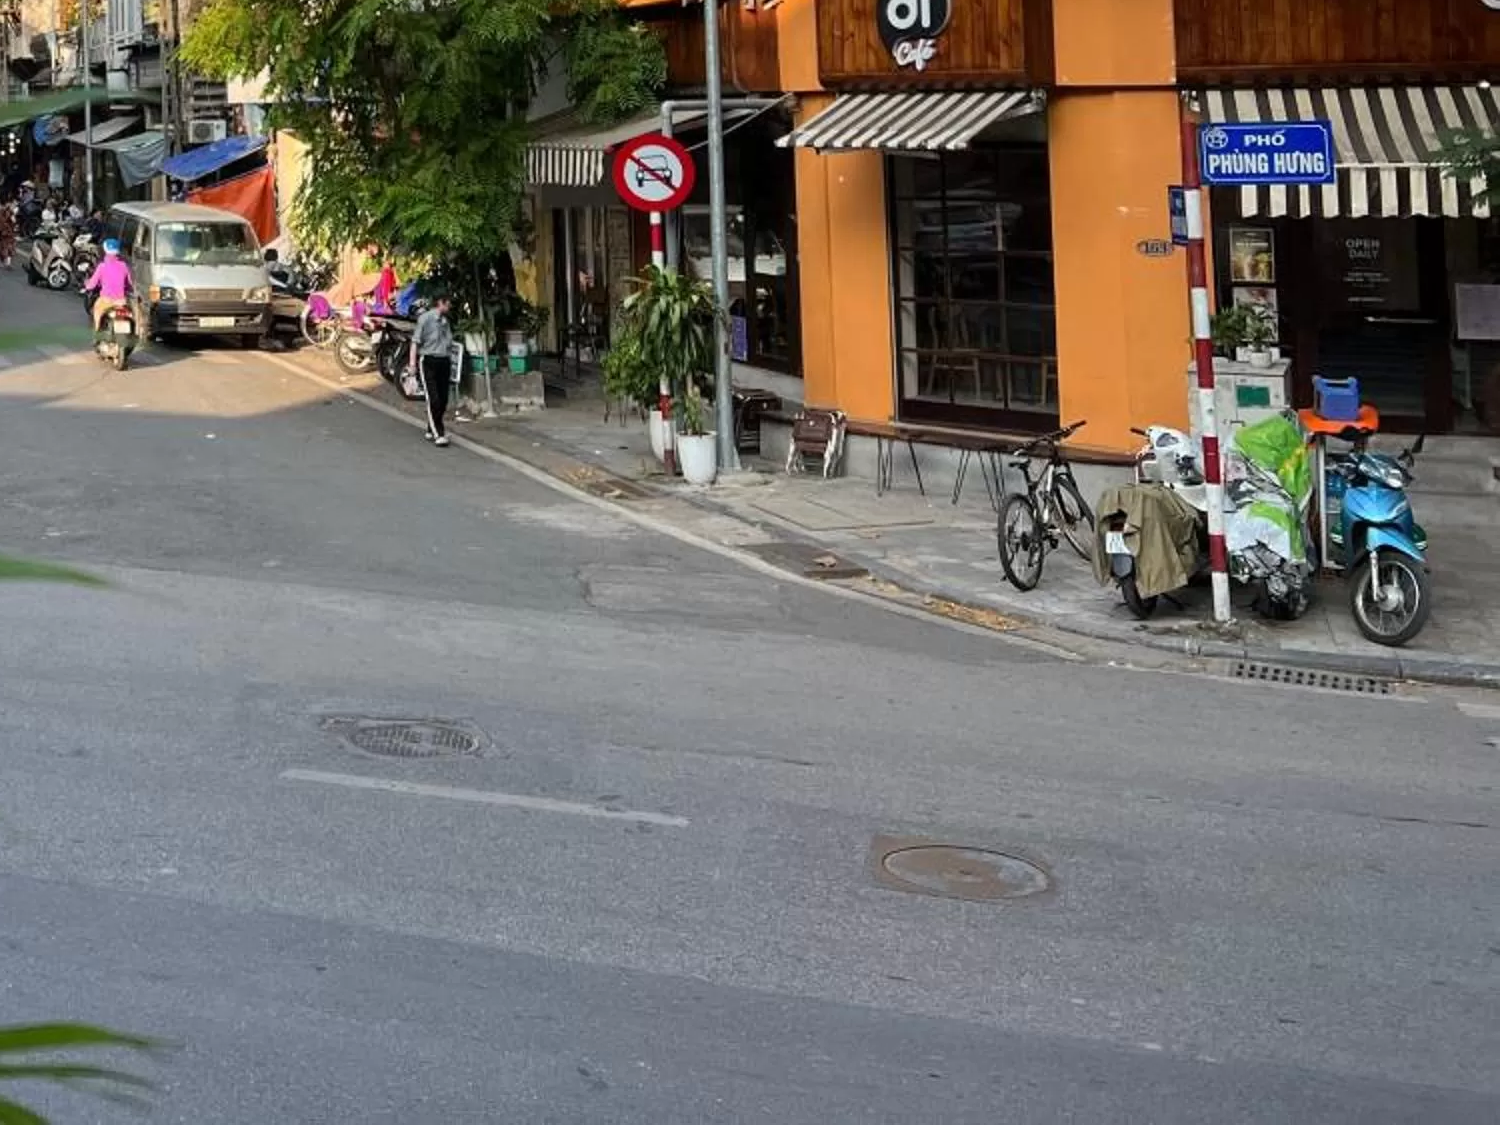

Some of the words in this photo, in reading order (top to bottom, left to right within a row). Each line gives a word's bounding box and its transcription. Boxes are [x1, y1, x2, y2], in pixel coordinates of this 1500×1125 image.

[1244, 129, 1286, 146] PHỐ
[1209, 148, 1269, 174] PHÙNG
[1273, 151, 1325, 174] HƯNG
